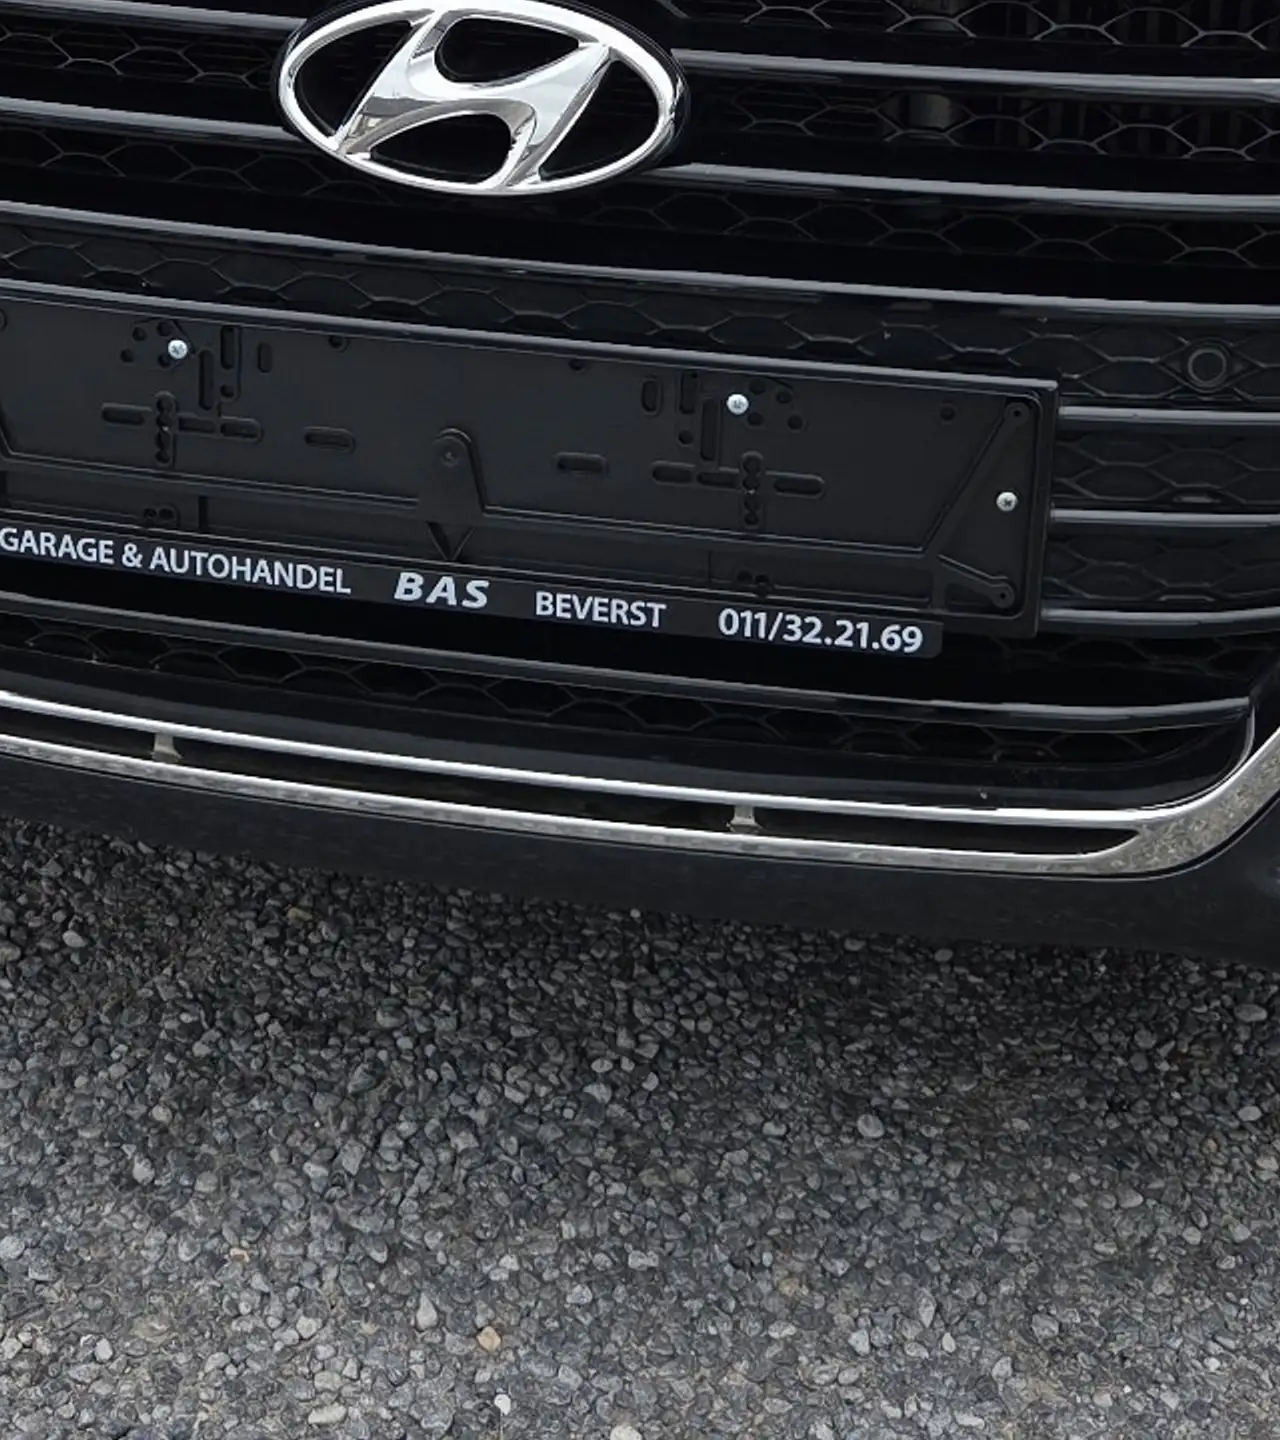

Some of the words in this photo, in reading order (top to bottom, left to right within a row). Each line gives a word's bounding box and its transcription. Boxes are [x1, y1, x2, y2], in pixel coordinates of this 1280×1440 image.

[122, 542, 143, 569] &
[149, 545, 352, 594] AUTOHANDEL
[393, 571, 490, 609] BAS
[535, 591, 667, 628] BEVERST
[719, 608, 924, 654] 011/32.21.69
